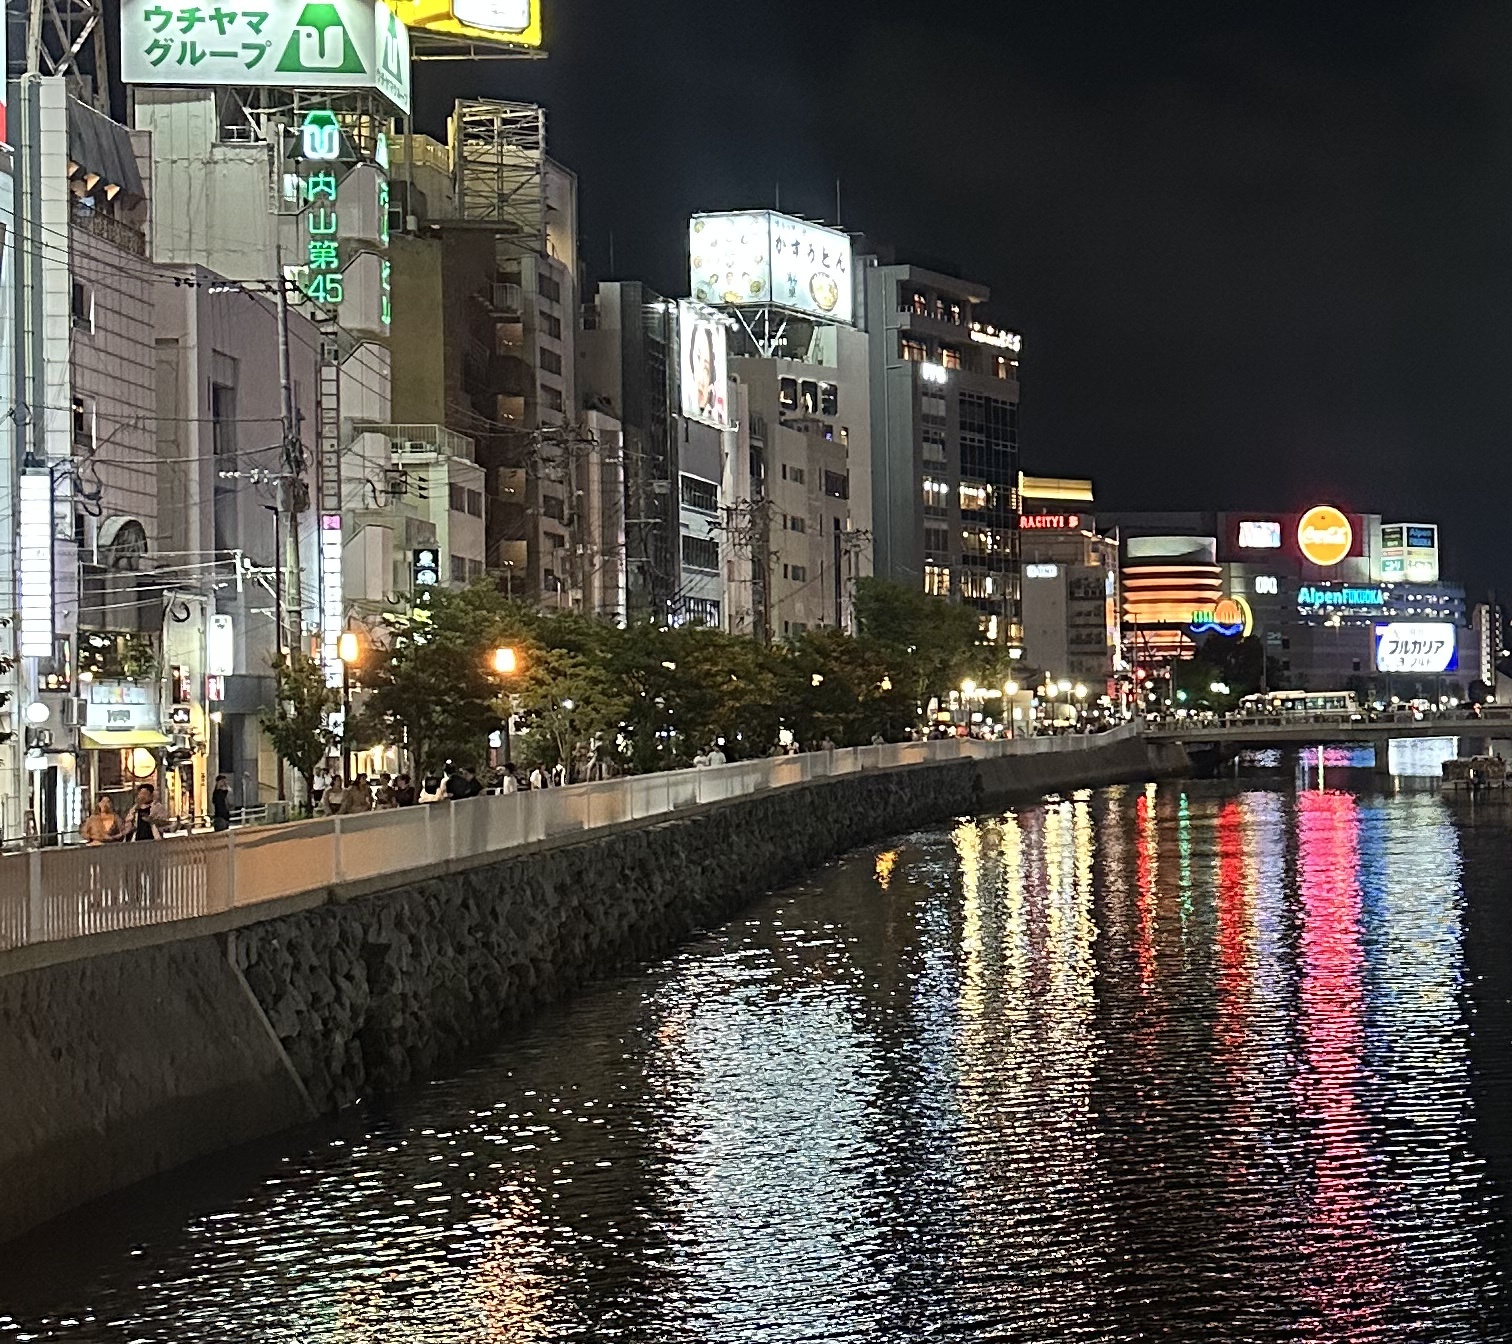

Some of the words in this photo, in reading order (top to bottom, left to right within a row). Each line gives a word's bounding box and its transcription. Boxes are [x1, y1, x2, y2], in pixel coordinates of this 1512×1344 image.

[144, 5, 270, 35] ウチヤマ
[144, 37, 273, 70] グループ
[307, 171, 343, 303] 内山第45
[1297, 586, 1342, 610] Alpen
